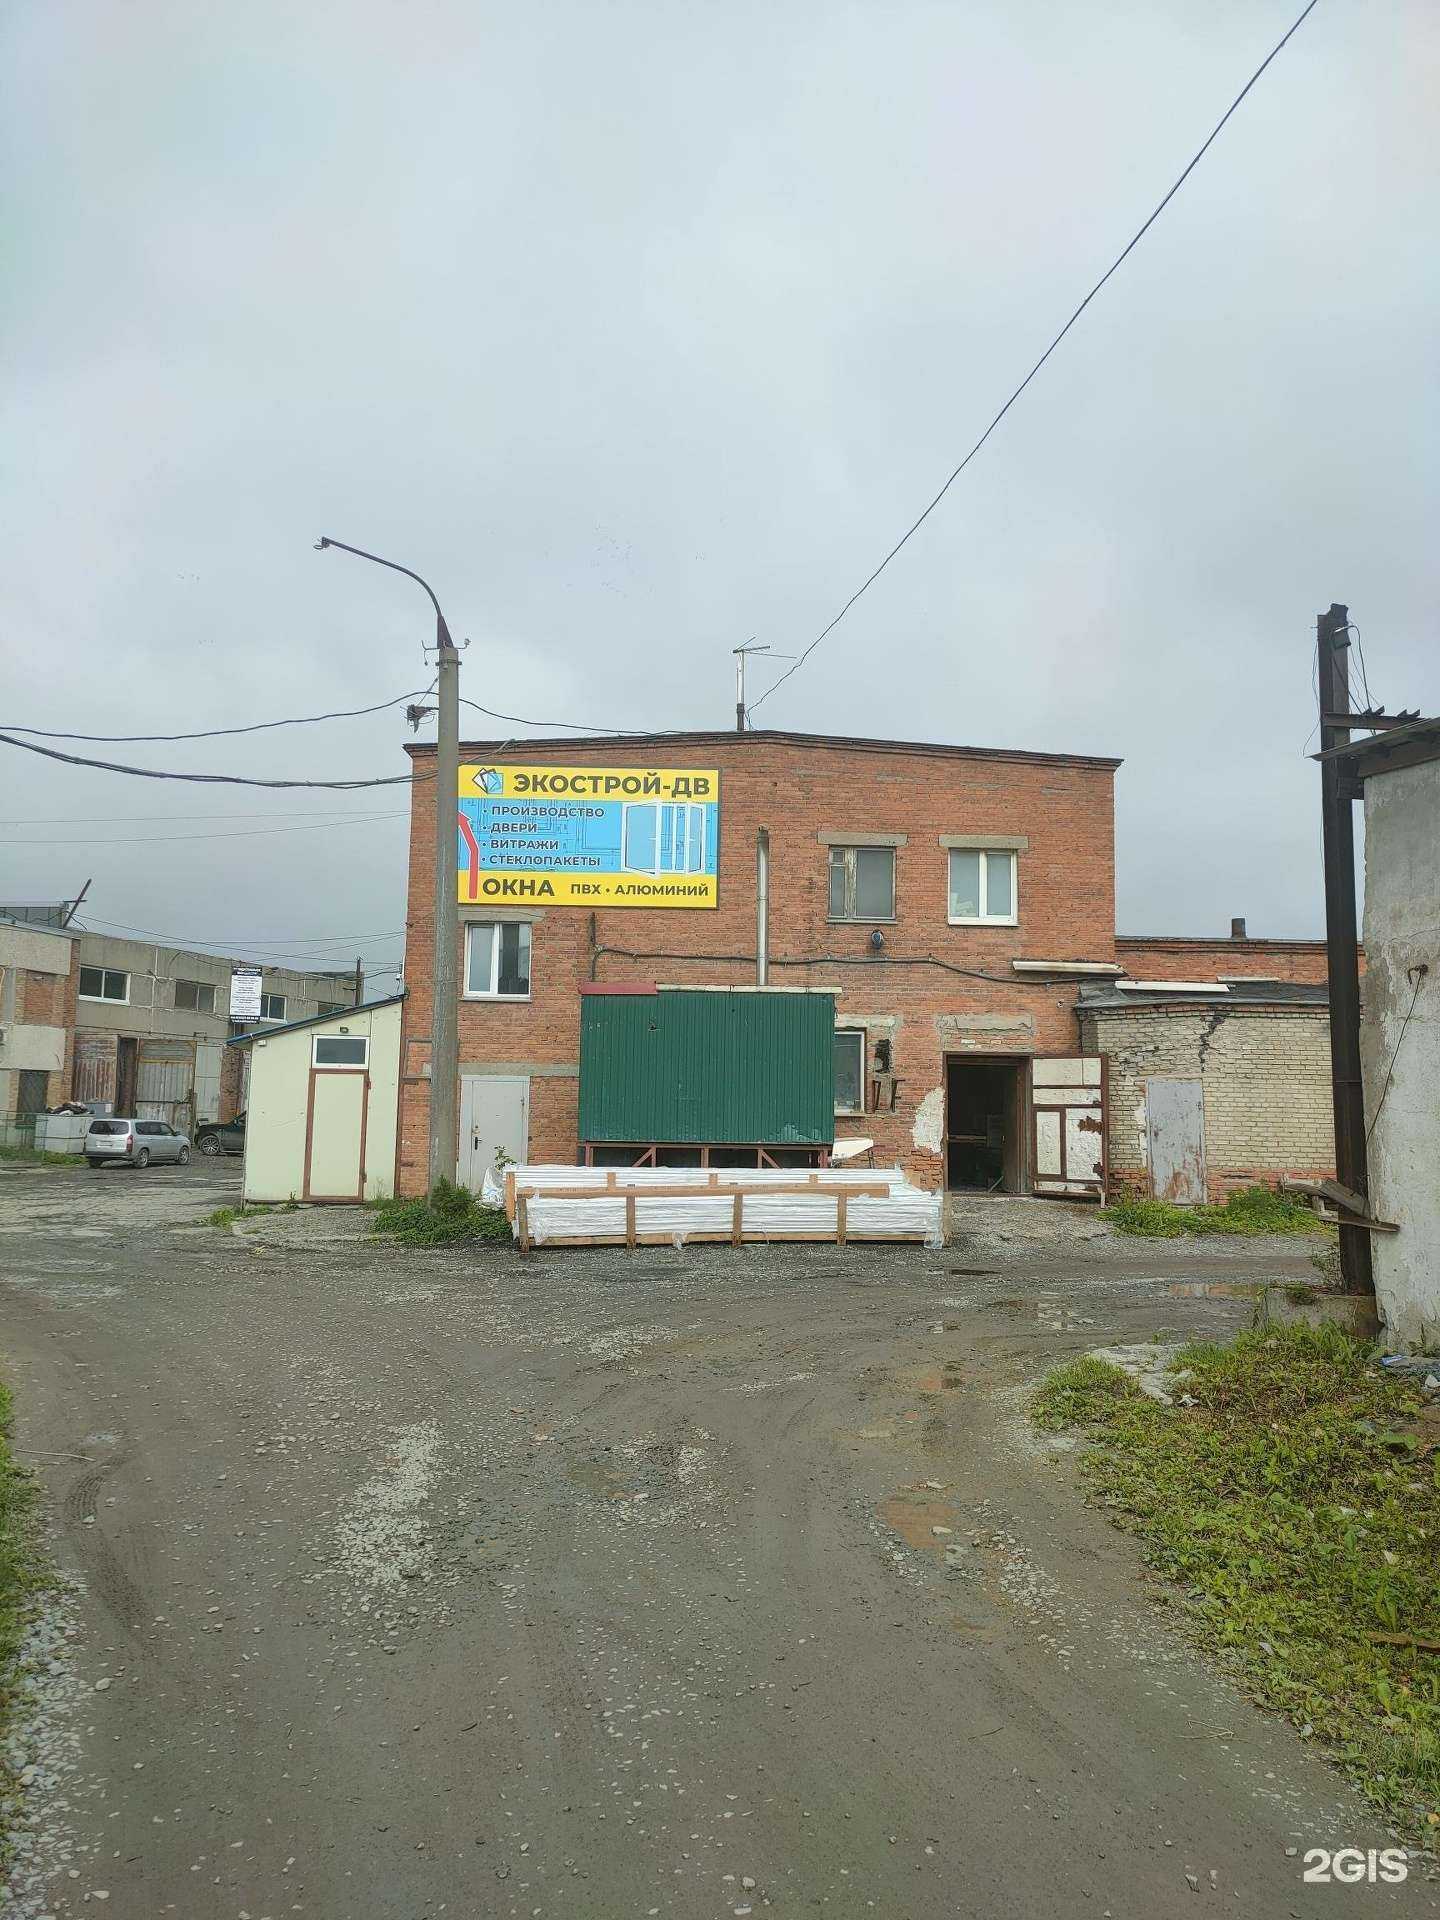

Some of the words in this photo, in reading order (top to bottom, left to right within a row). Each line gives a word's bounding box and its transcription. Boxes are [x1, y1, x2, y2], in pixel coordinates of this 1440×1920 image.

[513, 772, 710, 797] ЭКОСТРОЙ-ДВ
[491, 806, 605, 818] ПРОИЗВОДСТВО
[490, 822, 537, 833] ДВЕРИ
[490, 839, 559, 850] ВИТРАЖИ
[489, 854, 601, 866] СТЕКЛОПАКЕТЫ
[482, 878, 555, 897] ОКНА
[570, 883, 601, 895] ПВХ
[614, 882, 709, 897] АЛЮМИНИЙ
